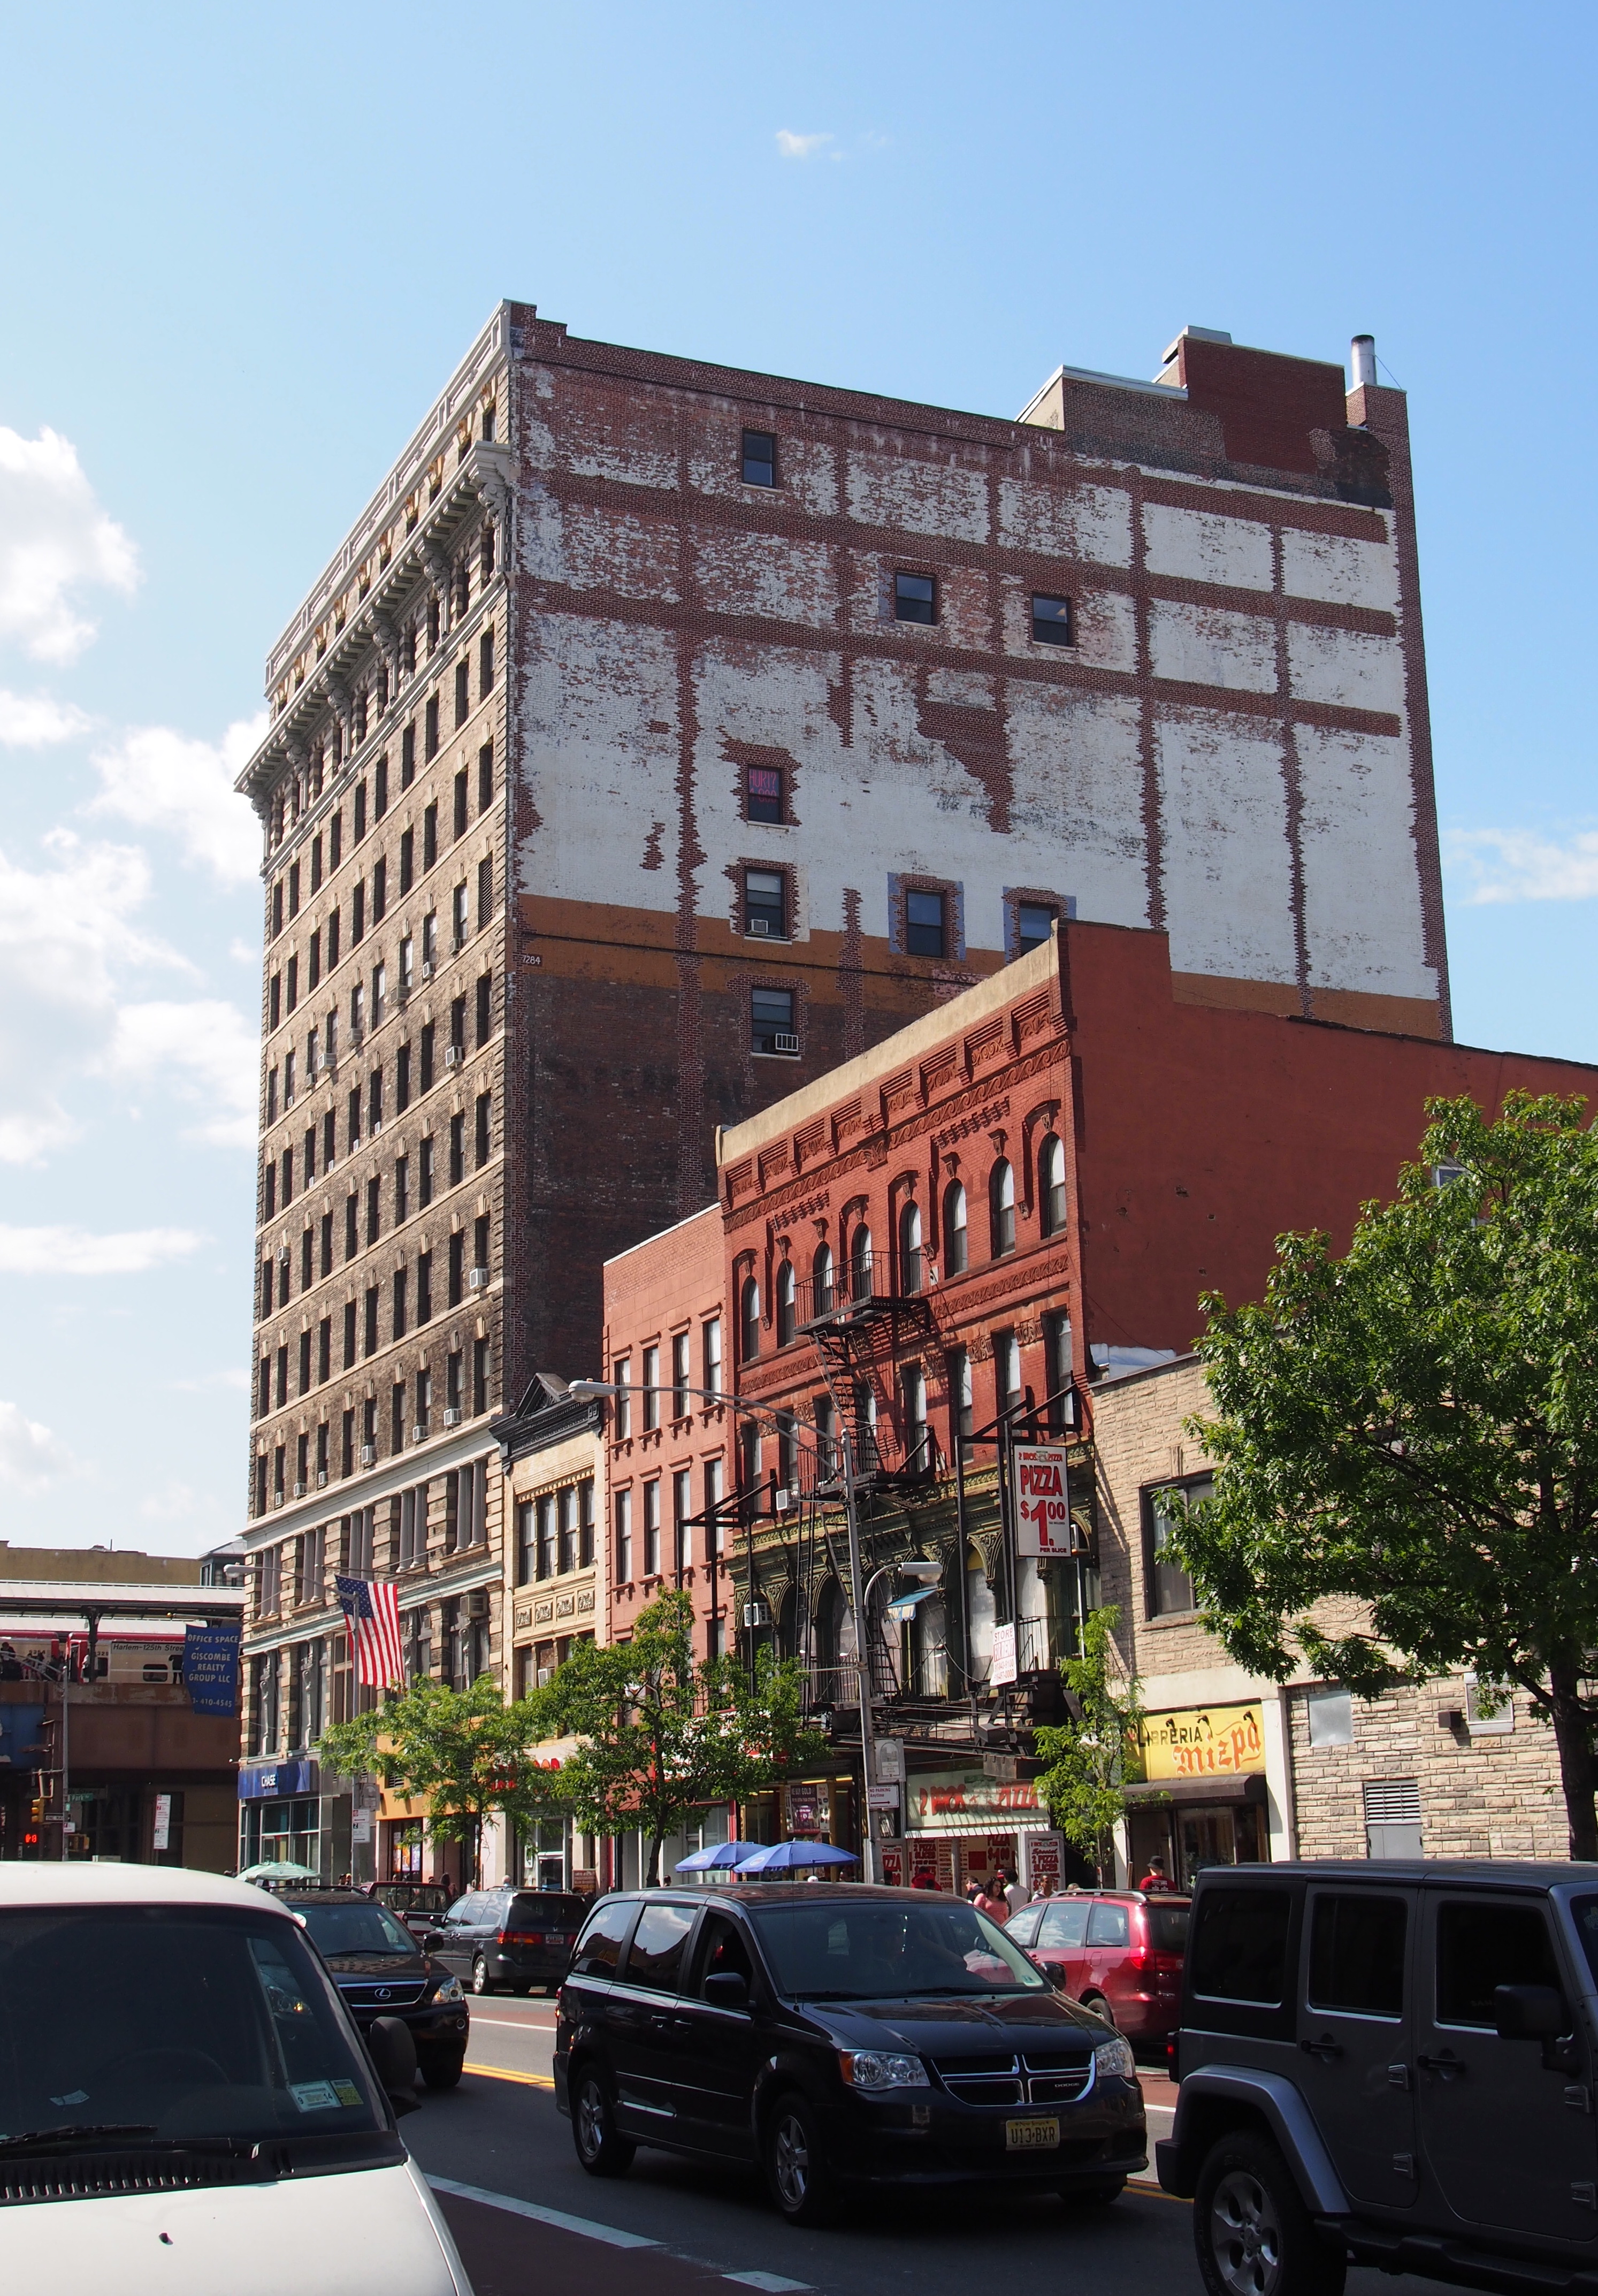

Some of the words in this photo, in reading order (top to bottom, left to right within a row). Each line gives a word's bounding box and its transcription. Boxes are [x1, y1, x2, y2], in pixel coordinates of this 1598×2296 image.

[750, 769, 776, 789] HURT?
[1020, 1464, 1063, 1496] PIZZA
[188, 1634, 212, 1643] OFFICE
[995, 1628, 1013, 1642] STORE
[191, 1653, 231, 1661] GISCOMBE
[189, 1674, 216, 1682] GROUP
[218, 1675, 230, 1683] LLC
[200, 1698, 232, 1707] 410-4545
[261, 1774, 276, 1787] CHASE
[920, 1788, 928, 1816] 2
[883, 1855, 901, 1871] IZZA
[1032, 1855, 1036, 1863] 2
[1038, 1855, 1058, 1863] PIZZA
[1034, 1863, 1058, 1872] SLICES
